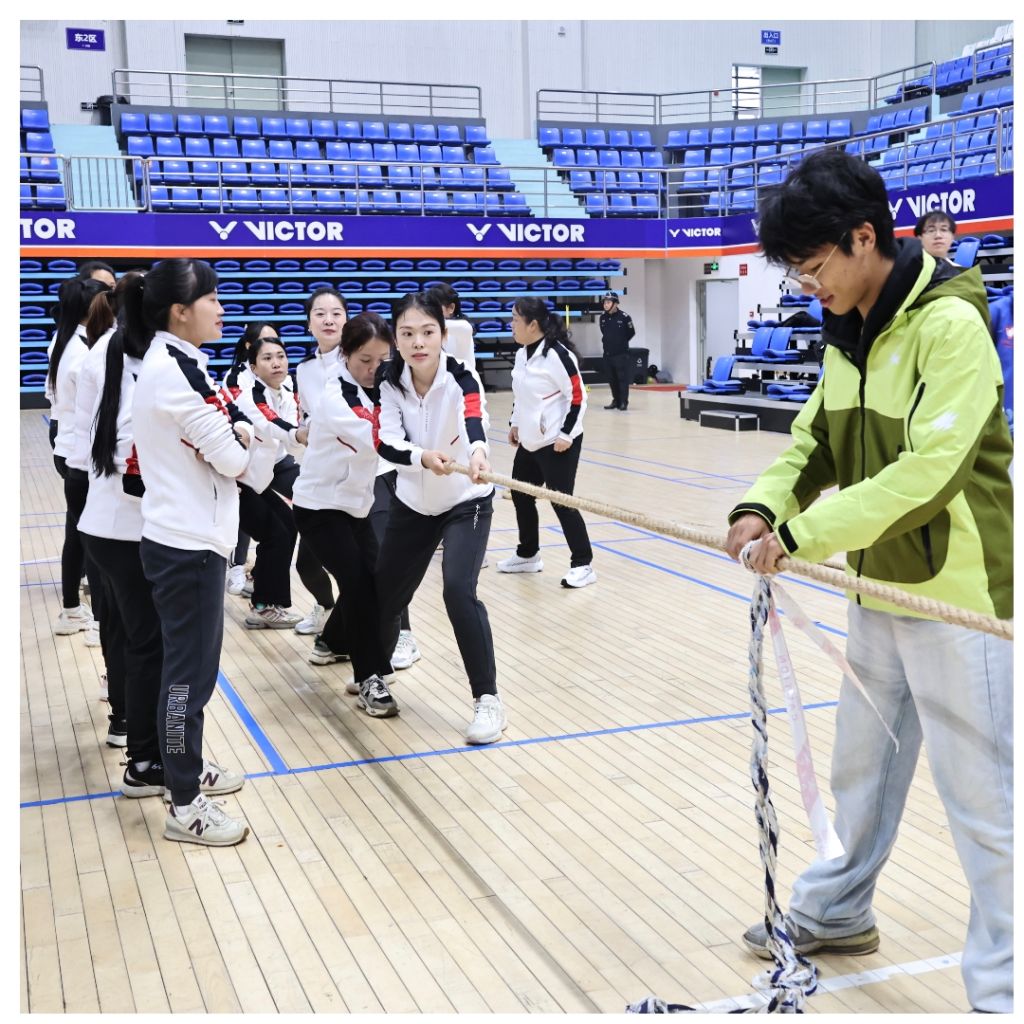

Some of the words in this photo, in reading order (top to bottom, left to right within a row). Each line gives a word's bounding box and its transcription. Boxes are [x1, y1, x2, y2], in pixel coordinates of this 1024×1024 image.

[75, 33, 98, 43] 东2区
[906, 188, 976, 218] VICTOR
[243, 220, 344, 241] VICTOR
[497, 223, 585, 243] VICTOR
[682, 226, 722, 238] VICTOR
[166, 684, 190, 754] URBANITE
[201, 771, 220, 787] N
